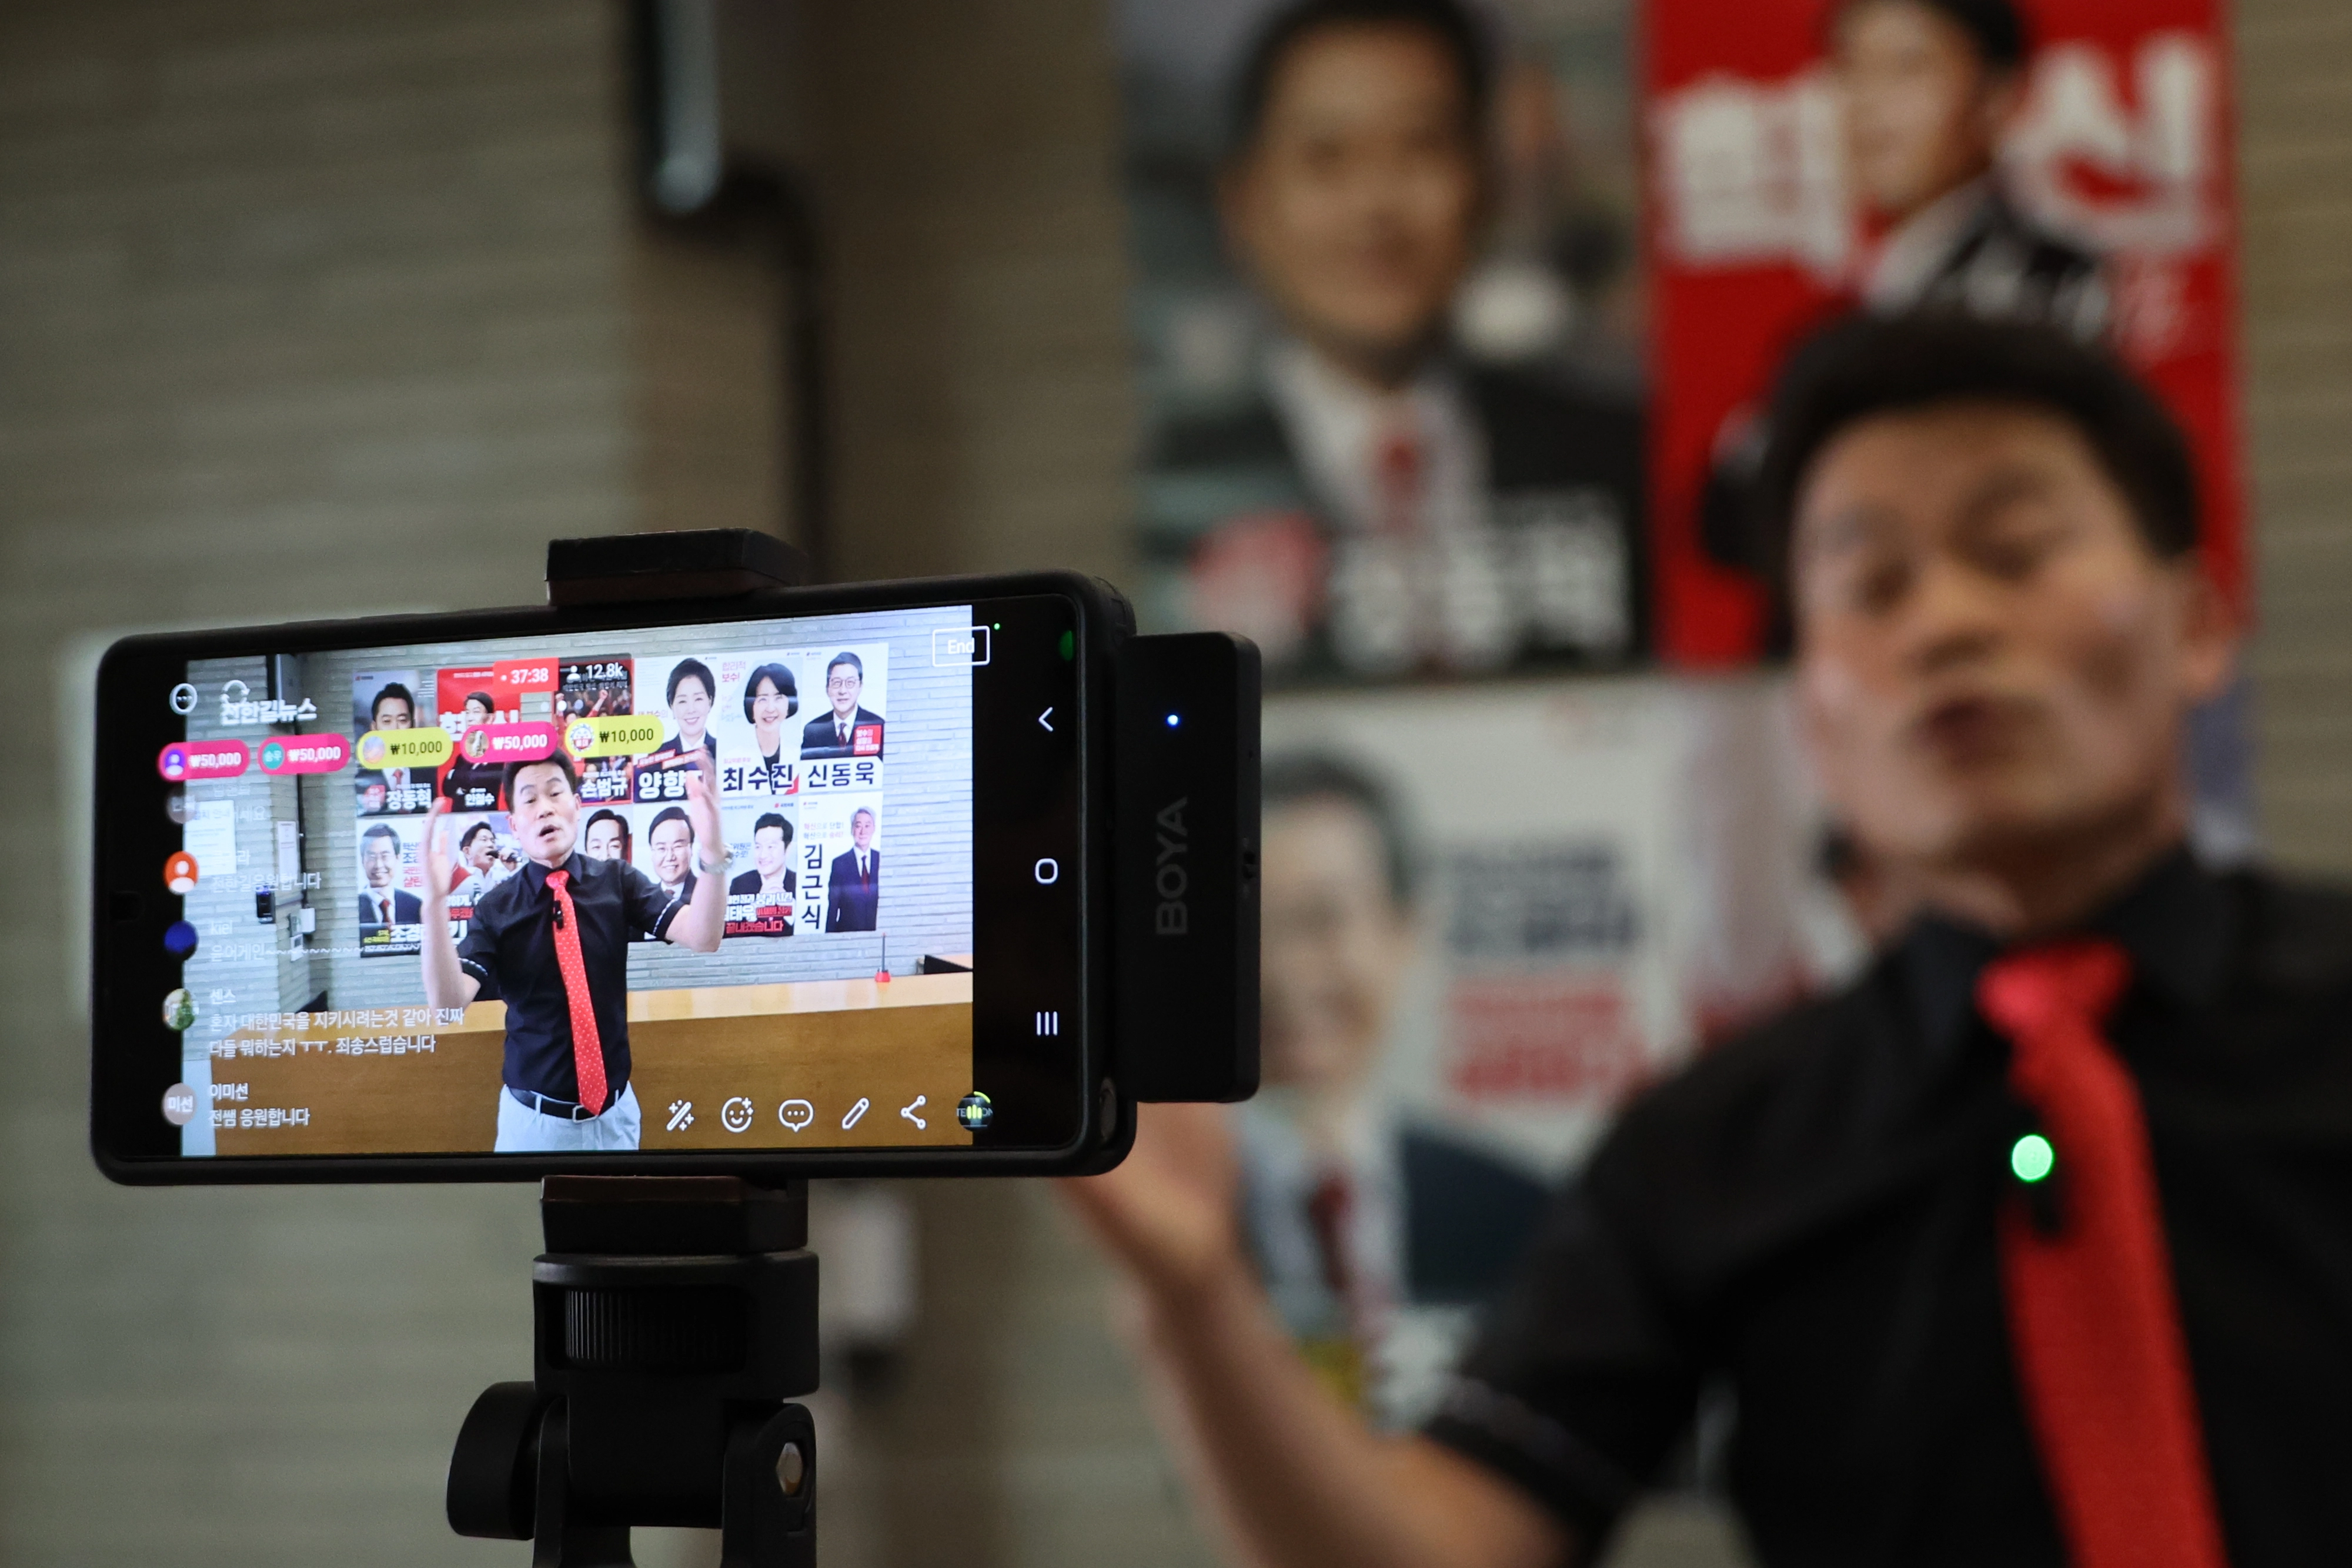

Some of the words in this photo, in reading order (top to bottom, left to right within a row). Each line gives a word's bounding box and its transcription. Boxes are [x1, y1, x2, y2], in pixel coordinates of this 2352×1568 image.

[948, 638, 975, 654] End
[510, 667, 549, 684] 37:38
[586, 662, 623, 680] 12.8k
[220, 698, 317, 726] 전한길뉴스
[492, 734, 547, 751] ₩50,000
[599, 728, 654, 744] ₩10,000
[287, 746, 341, 763] ₩50,000
[390, 741, 442, 756] ₩10,000
[189, 752, 242, 769] ₩50,000
[723, 764, 793, 791] 최수진
[808, 762, 874, 788] 신동욱
[580, 777, 628, 798] 손범규
[386, 787, 433, 810] 장동혁
[465, 793, 495, 807] 안철수
[1156, 796, 1188, 935] BOYA
[801, 844, 823, 930] 김근식
[390, 924, 425, 943] 조경
[210, 988, 236, 1004] 센스
[210, 1014, 238, 1032] 혼자
[241, 1011, 310, 1031] 대한민국을
[314, 1009, 398, 1029] 지키시려는것
[402, 1008, 432, 1027] 같아
[435, 1007, 465, 1026] 진짜
[210, 1039, 237, 1057] 다들
[240, 1038, 296, 1057] 뭐하는지
[336, 1034, 436, 1055] 죄송스럽습니다
[210, 1082, 249, 1101] 이미선
[168, 1095, 193, 1112] 미선
[209, 1109, 237, 1126] 전쌤
[240, 1107, 310, 1127] 응원합니다
